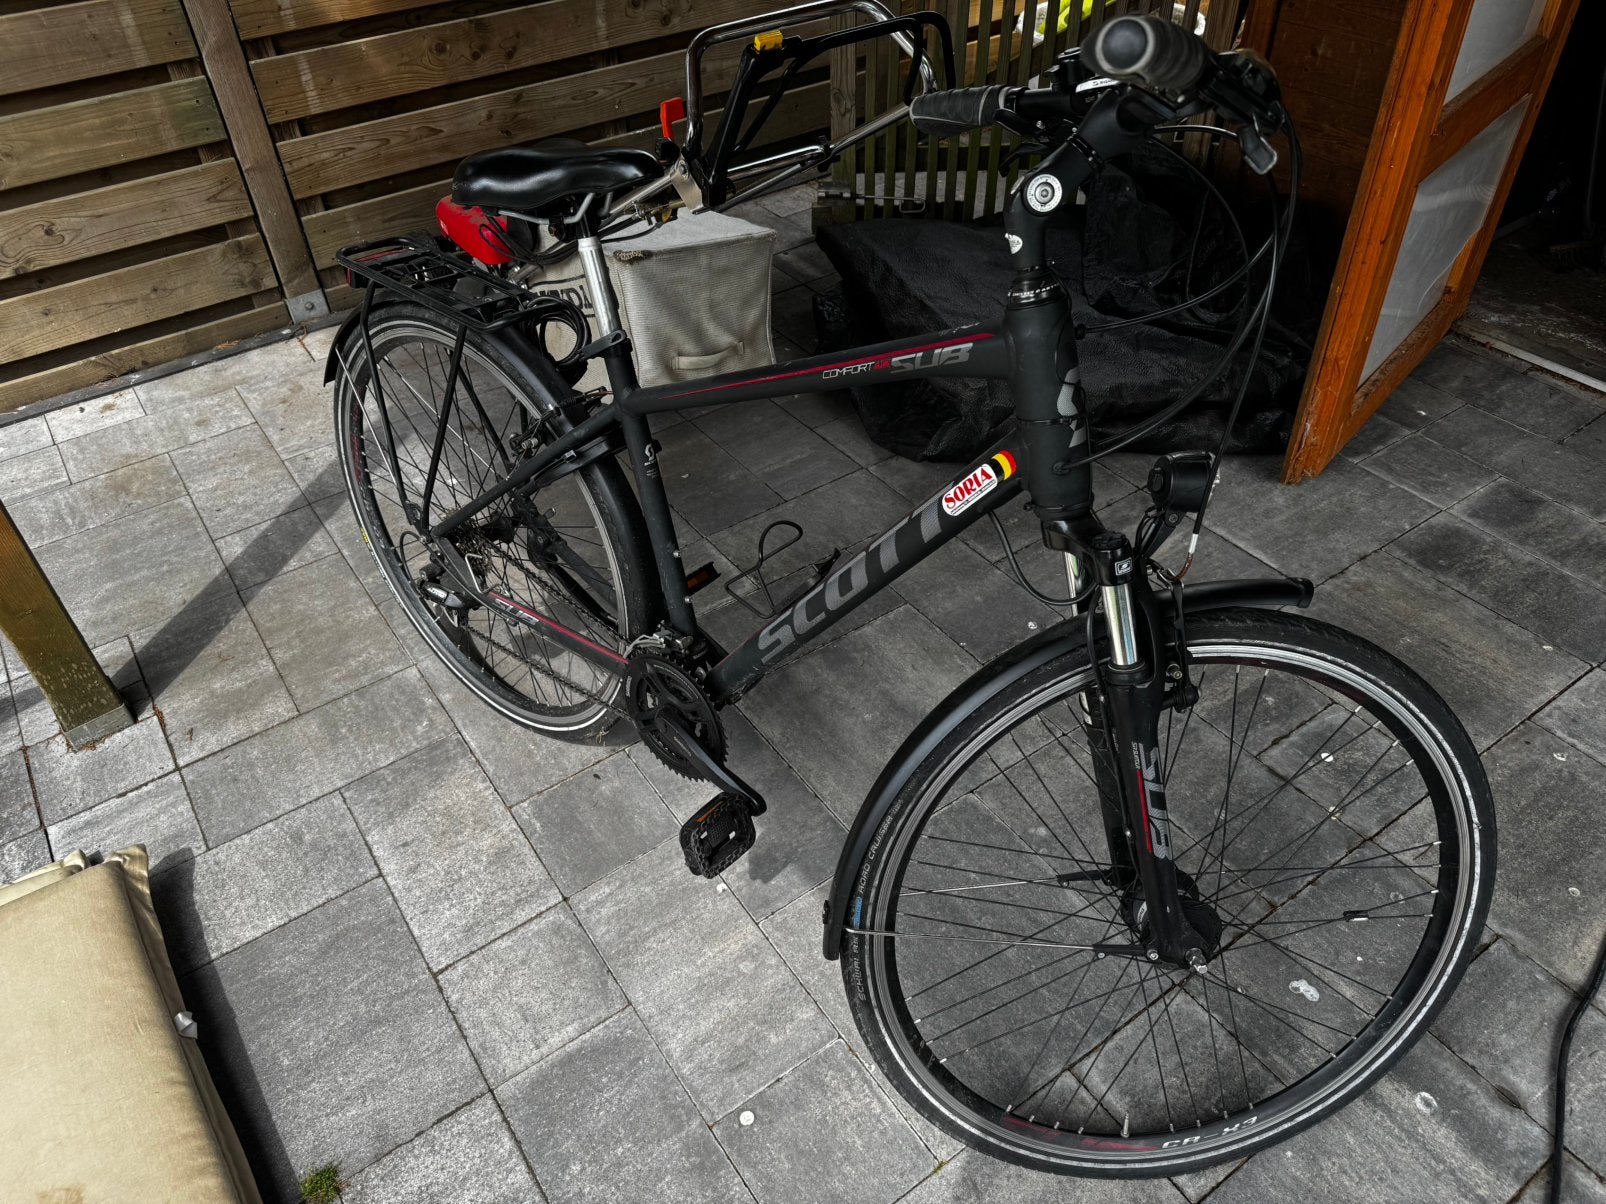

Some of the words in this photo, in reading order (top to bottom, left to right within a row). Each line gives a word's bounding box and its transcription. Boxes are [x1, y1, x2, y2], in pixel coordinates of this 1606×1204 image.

[822, 361, 876, 380] COMFORT
[891, 342, 974, 374] SUB
[944, 467, 994, 510] SORIA
[758, 480, 955, 665] SCOTT
[492, 598, 540, 626] SUB
[1138, 742, 1174, 861] SUB
